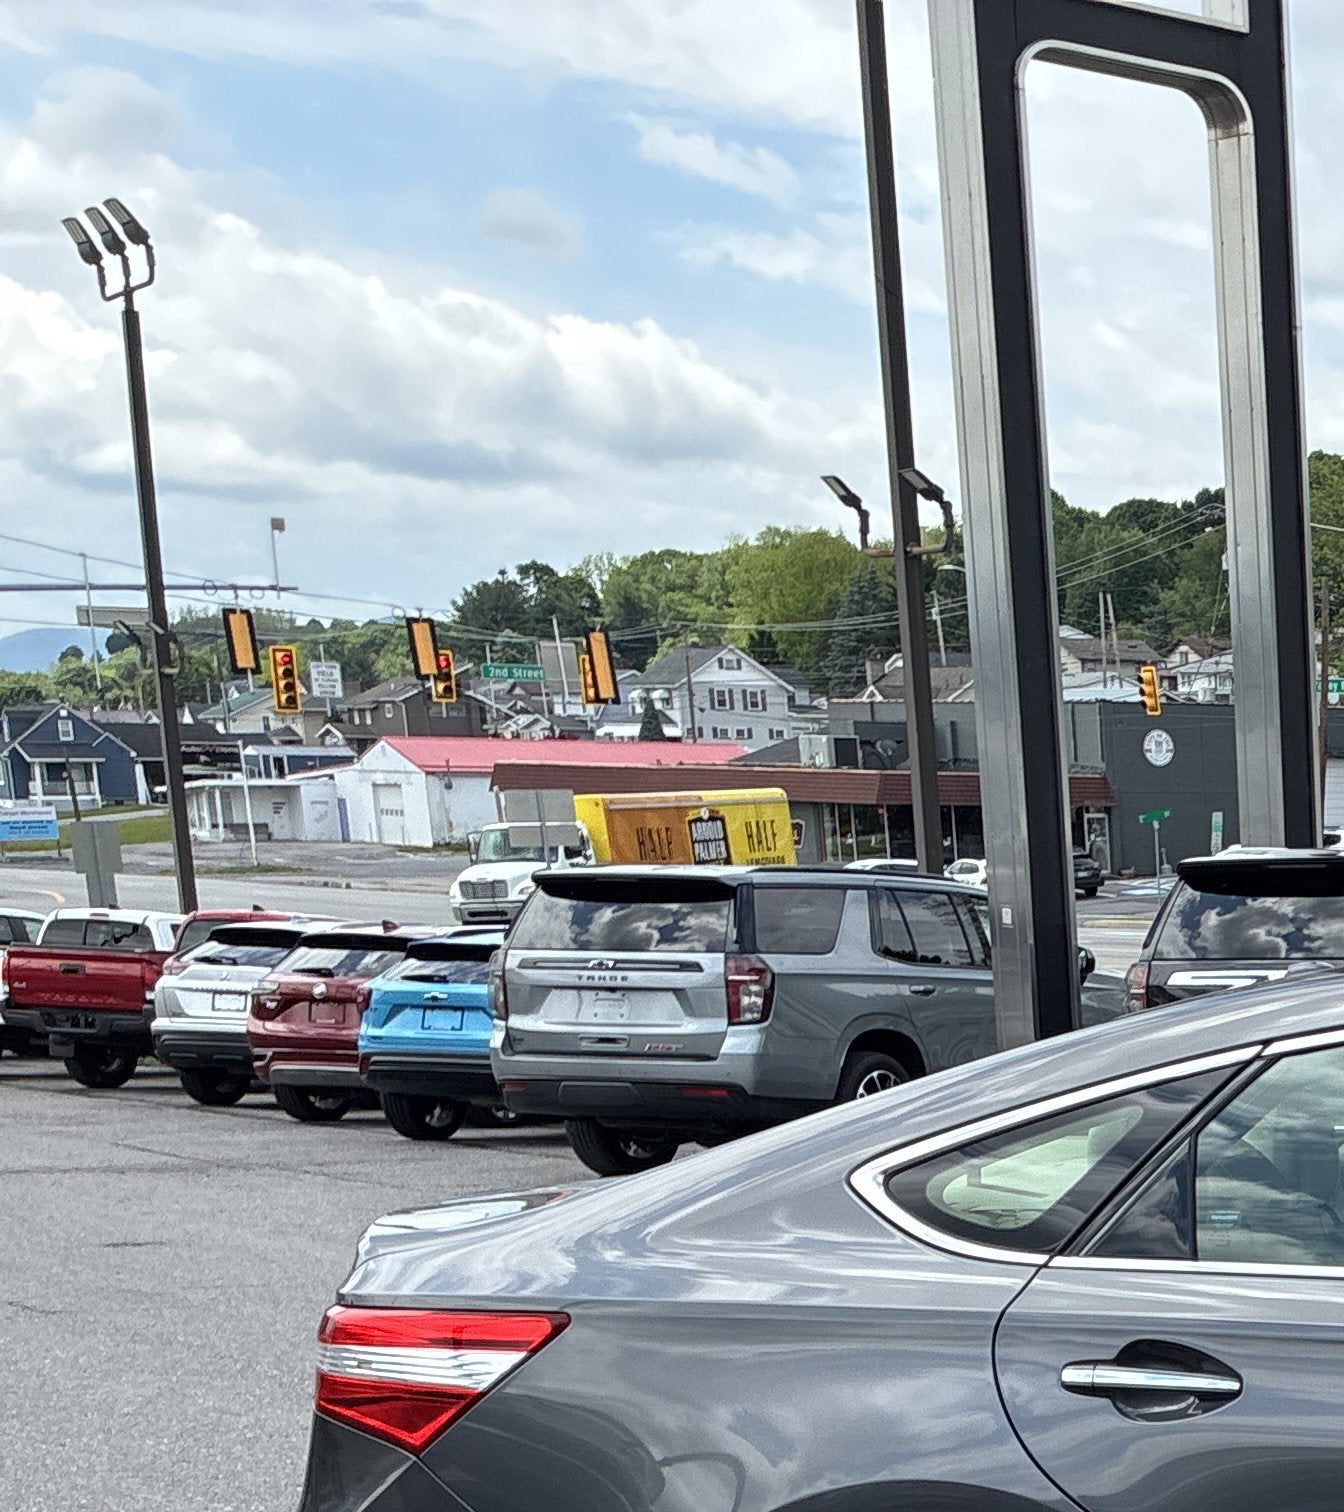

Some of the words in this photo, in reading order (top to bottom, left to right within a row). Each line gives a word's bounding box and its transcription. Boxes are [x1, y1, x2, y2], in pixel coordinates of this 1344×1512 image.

[489, 666, 509, 678] 2nd
[512, 667, 544, 679] Street
[636, 826, 674, 861] HALF
[744, 819, 778, 854] HALF
